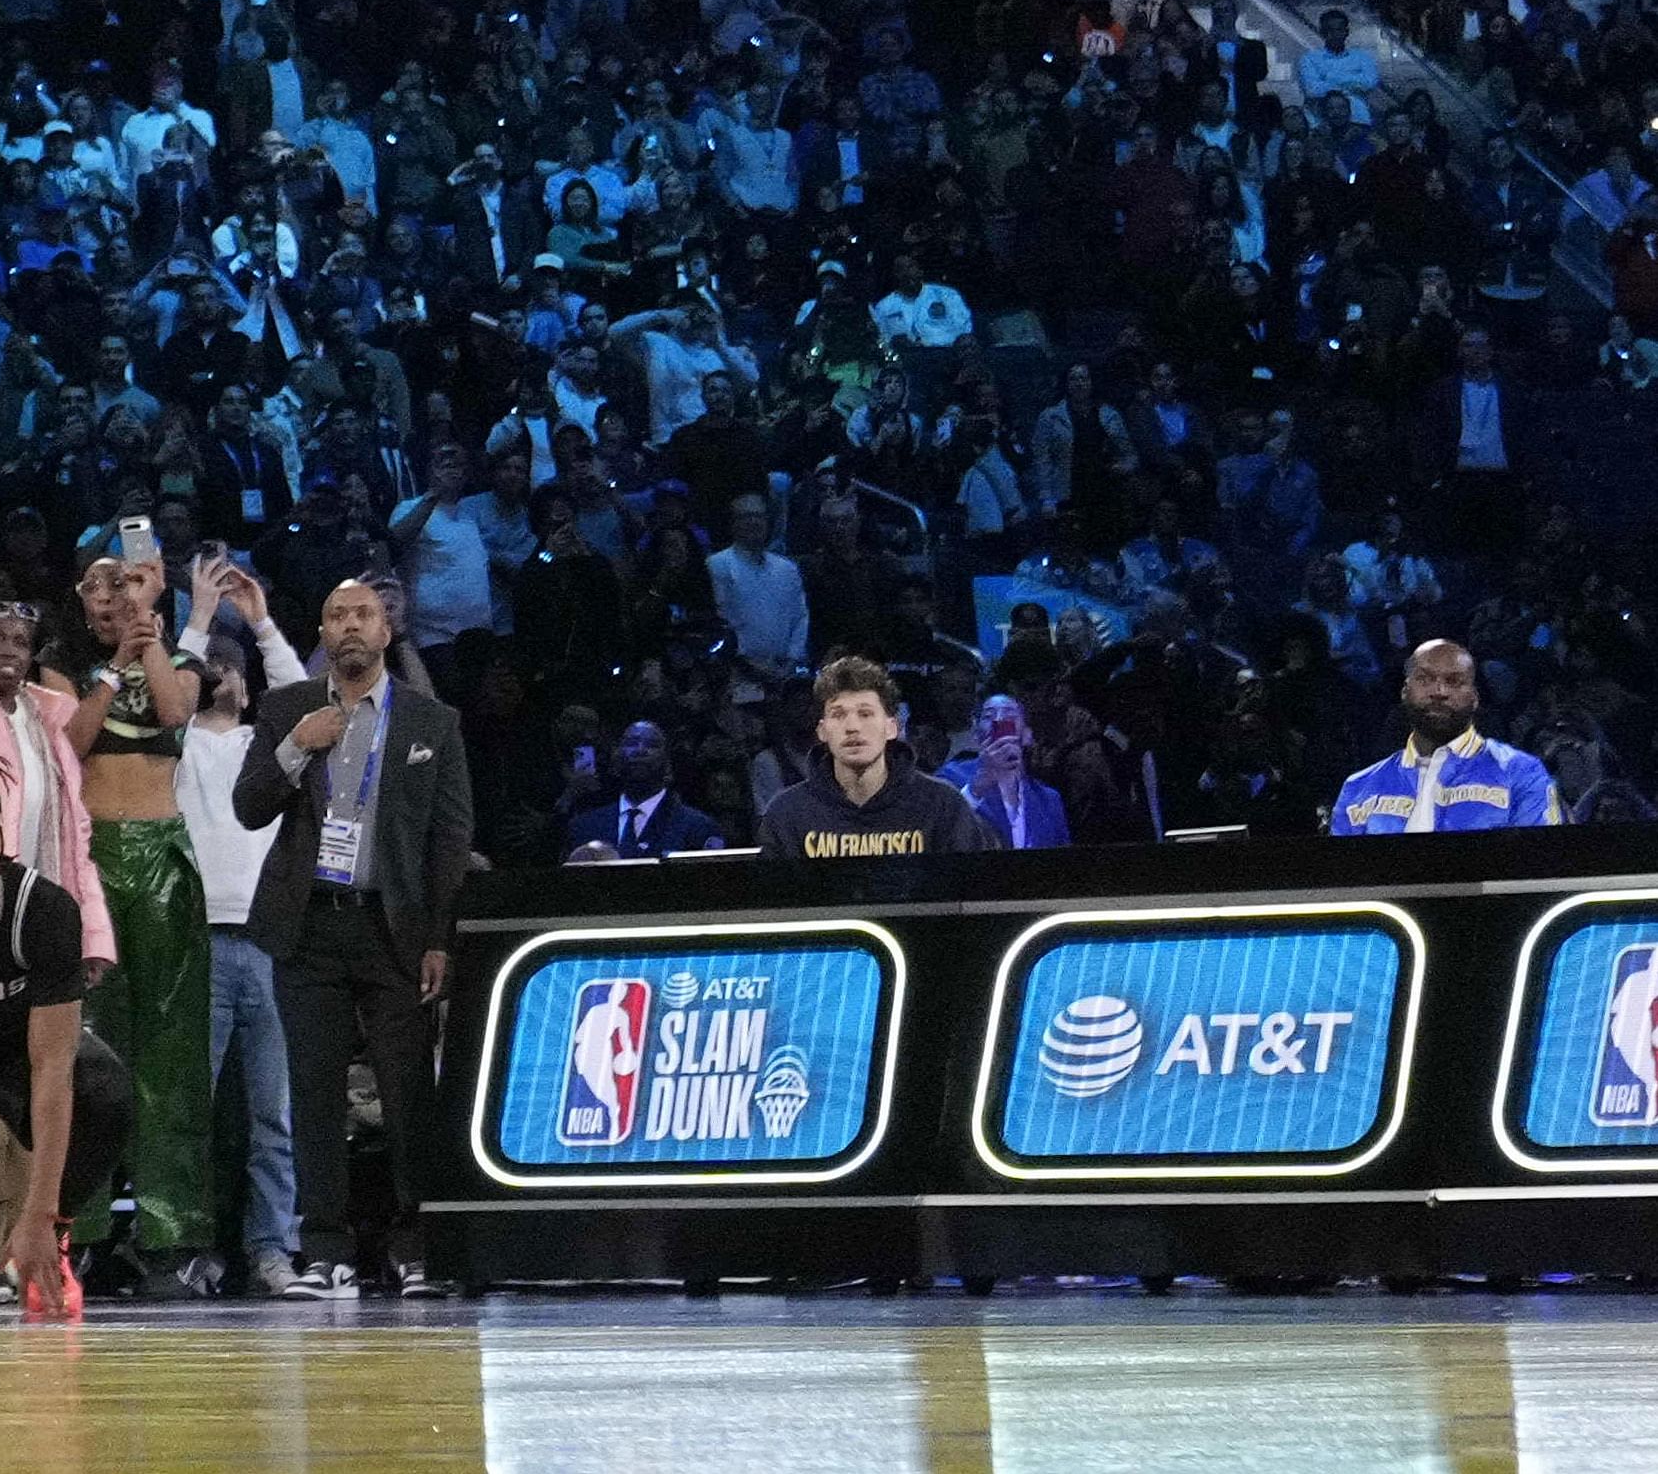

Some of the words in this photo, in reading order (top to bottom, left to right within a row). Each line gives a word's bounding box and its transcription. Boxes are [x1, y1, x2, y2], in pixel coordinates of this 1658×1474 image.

[702, 975, 771, 1000] AT&T
[660, 1008, 766, 1076] SLAM
[1153, 1008, 1353, 1077] AT&T
[566, 1106, 604, 1135] NBA
[644, 1078, 756, 1142] DUNK
[1600, 1084, 1641, 1115] NBA
